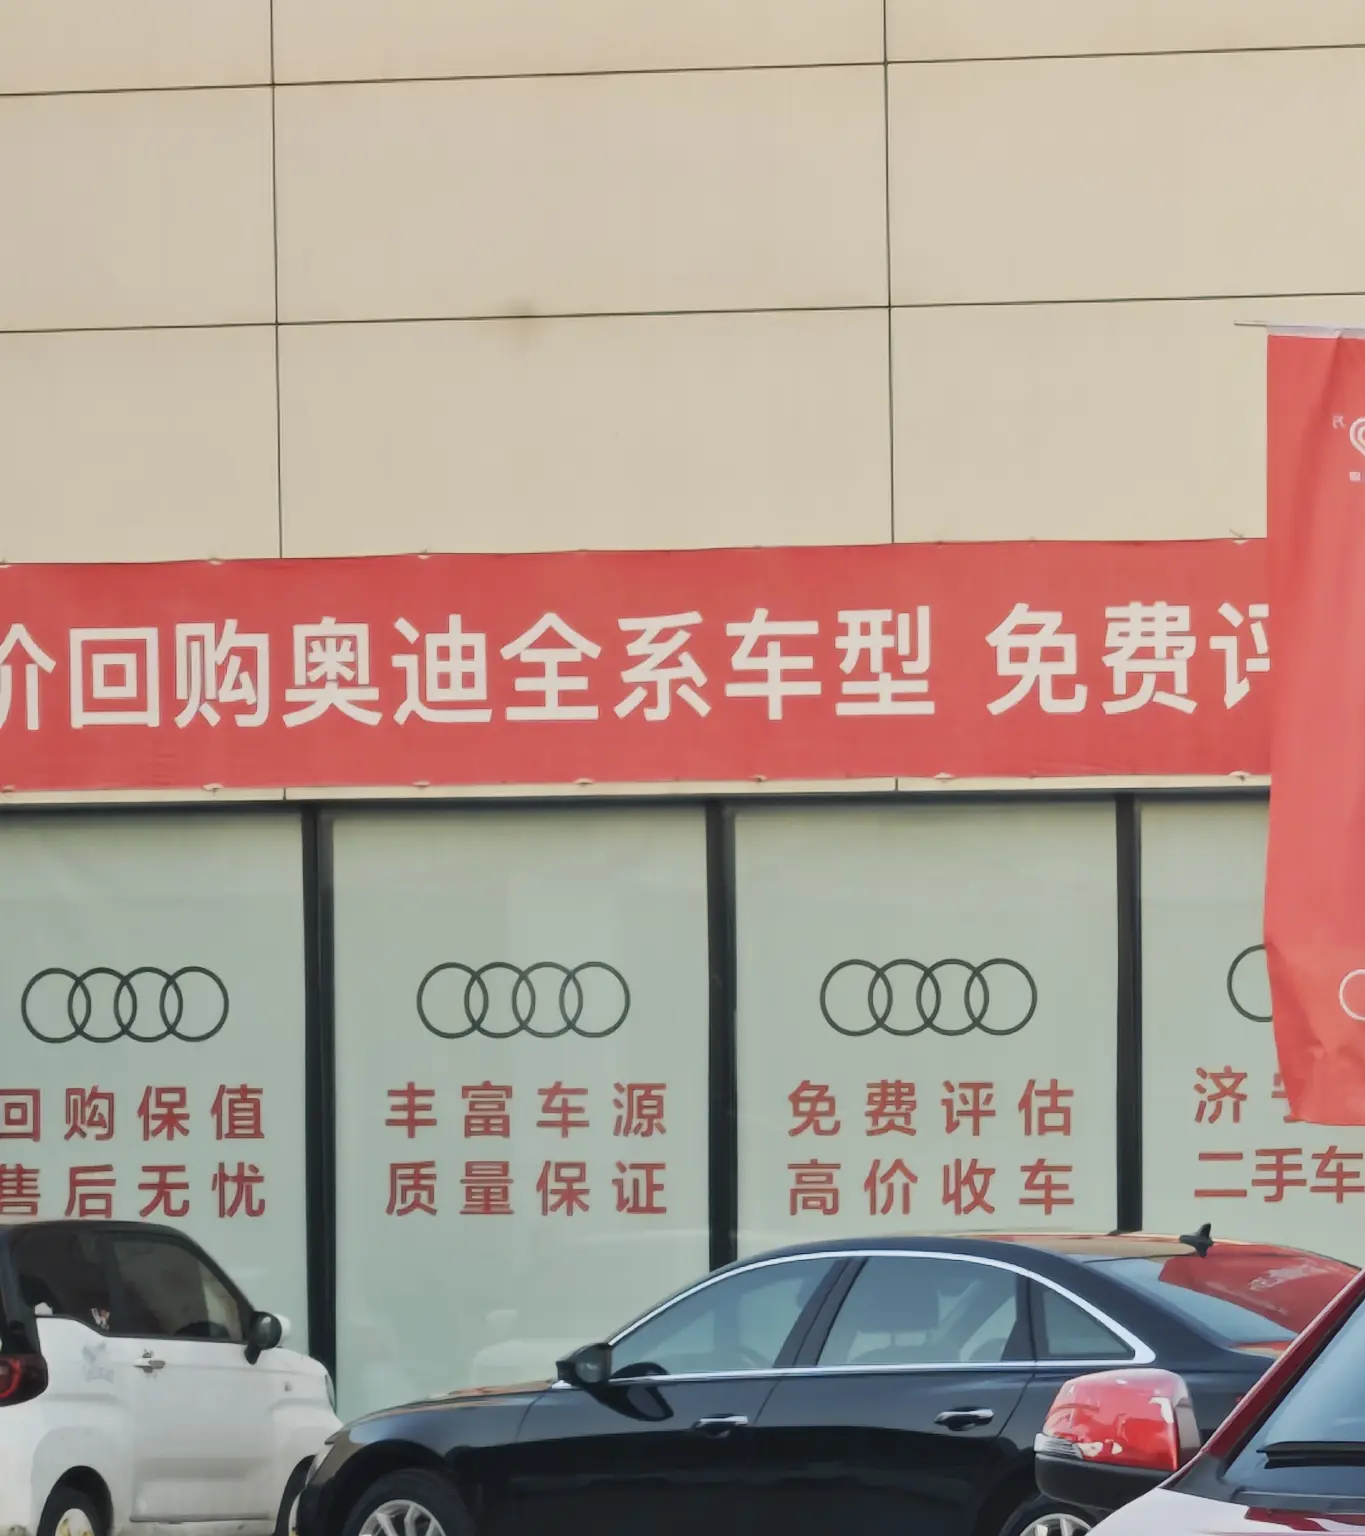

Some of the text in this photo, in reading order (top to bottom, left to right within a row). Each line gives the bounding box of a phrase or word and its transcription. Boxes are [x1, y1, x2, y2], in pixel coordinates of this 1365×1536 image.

[0, 1084, 266, 1142] 回购保值
[385, 1081, 668, 1139] 丰富车源
[788, 1079, 1075, 1138] 免费评估
[0, 1162, 266, 1218] 售后无忧
[385, 1160, 668, 1217] 质量保证
[788, 1158, 1075, 1216] 高价收车
